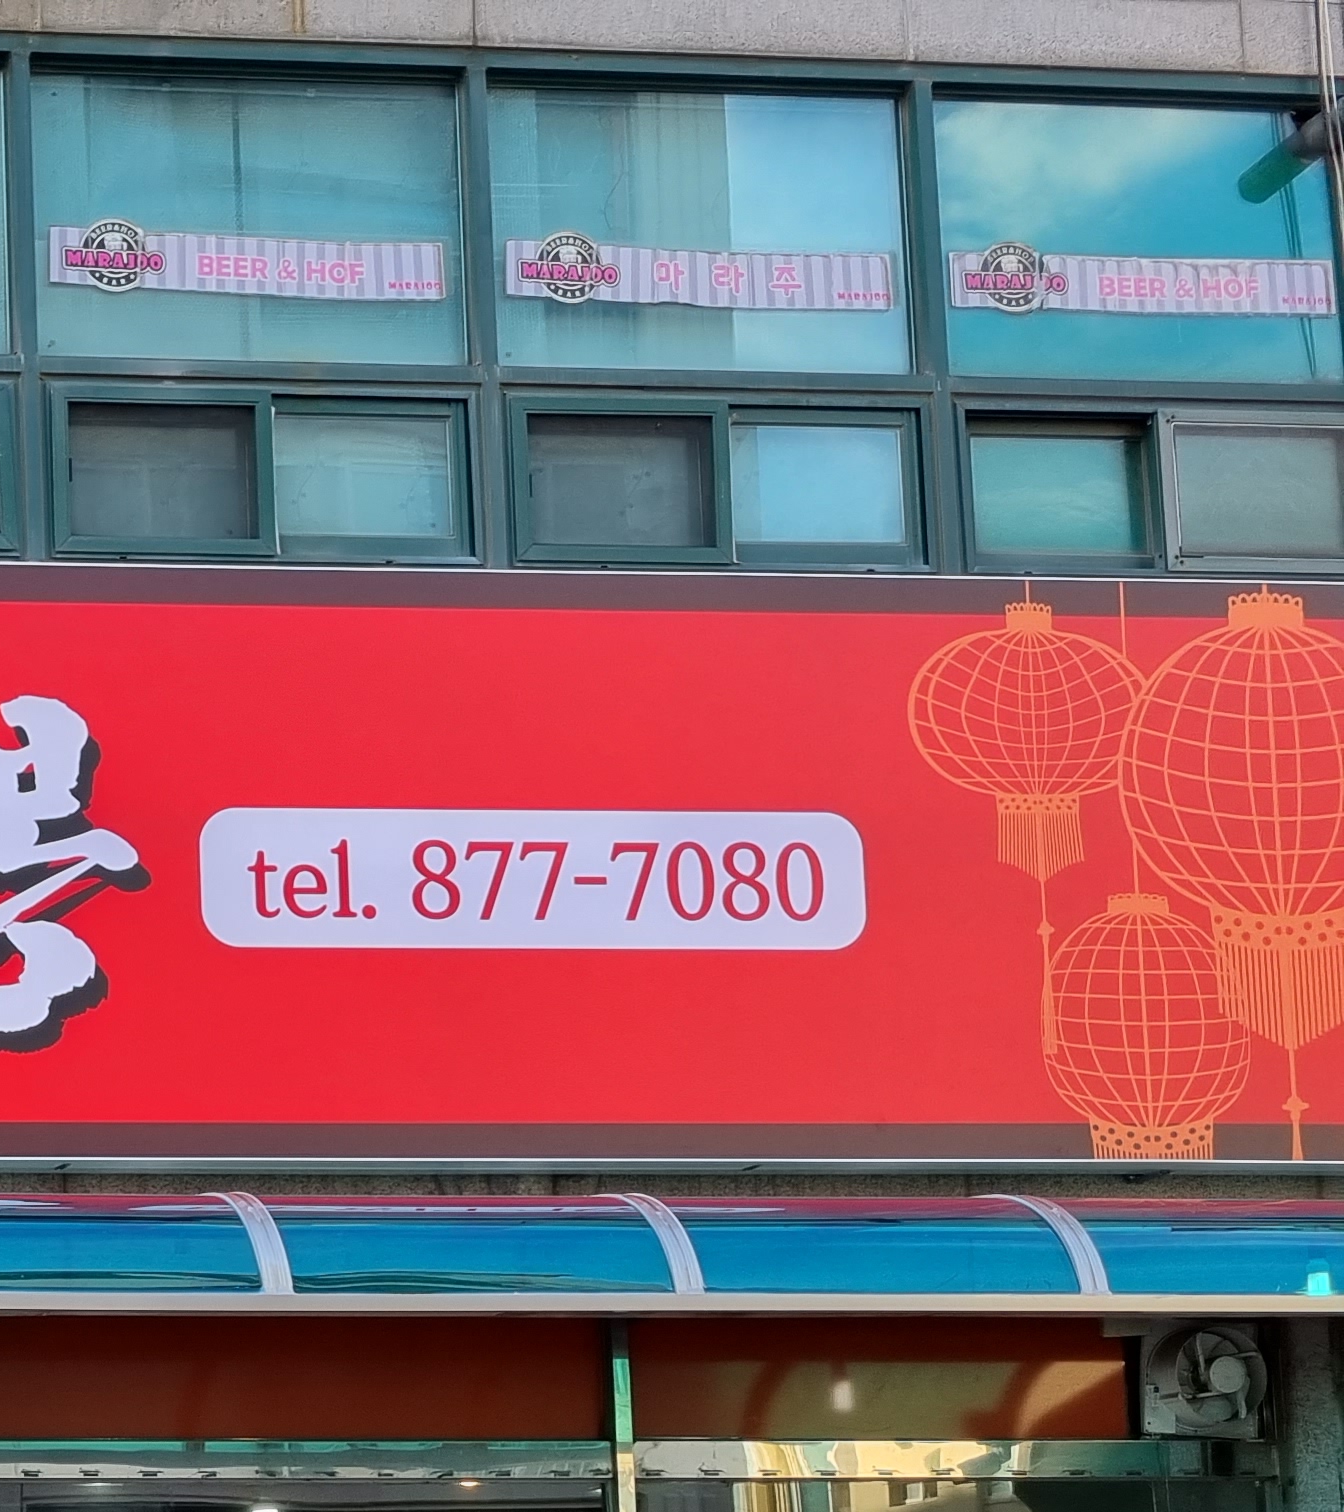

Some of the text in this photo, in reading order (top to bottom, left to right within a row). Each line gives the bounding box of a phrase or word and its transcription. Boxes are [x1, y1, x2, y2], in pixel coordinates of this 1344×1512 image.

[65, 248, 164, 272] MARAJOO
[197, 254, 366, 284] BEER & HOF
[521, 261, 619, 284] MARAJOO
[1098, 274, 1260, 300] BEER & HOF
[246, 839, 828, 923] tel. 877-7080
